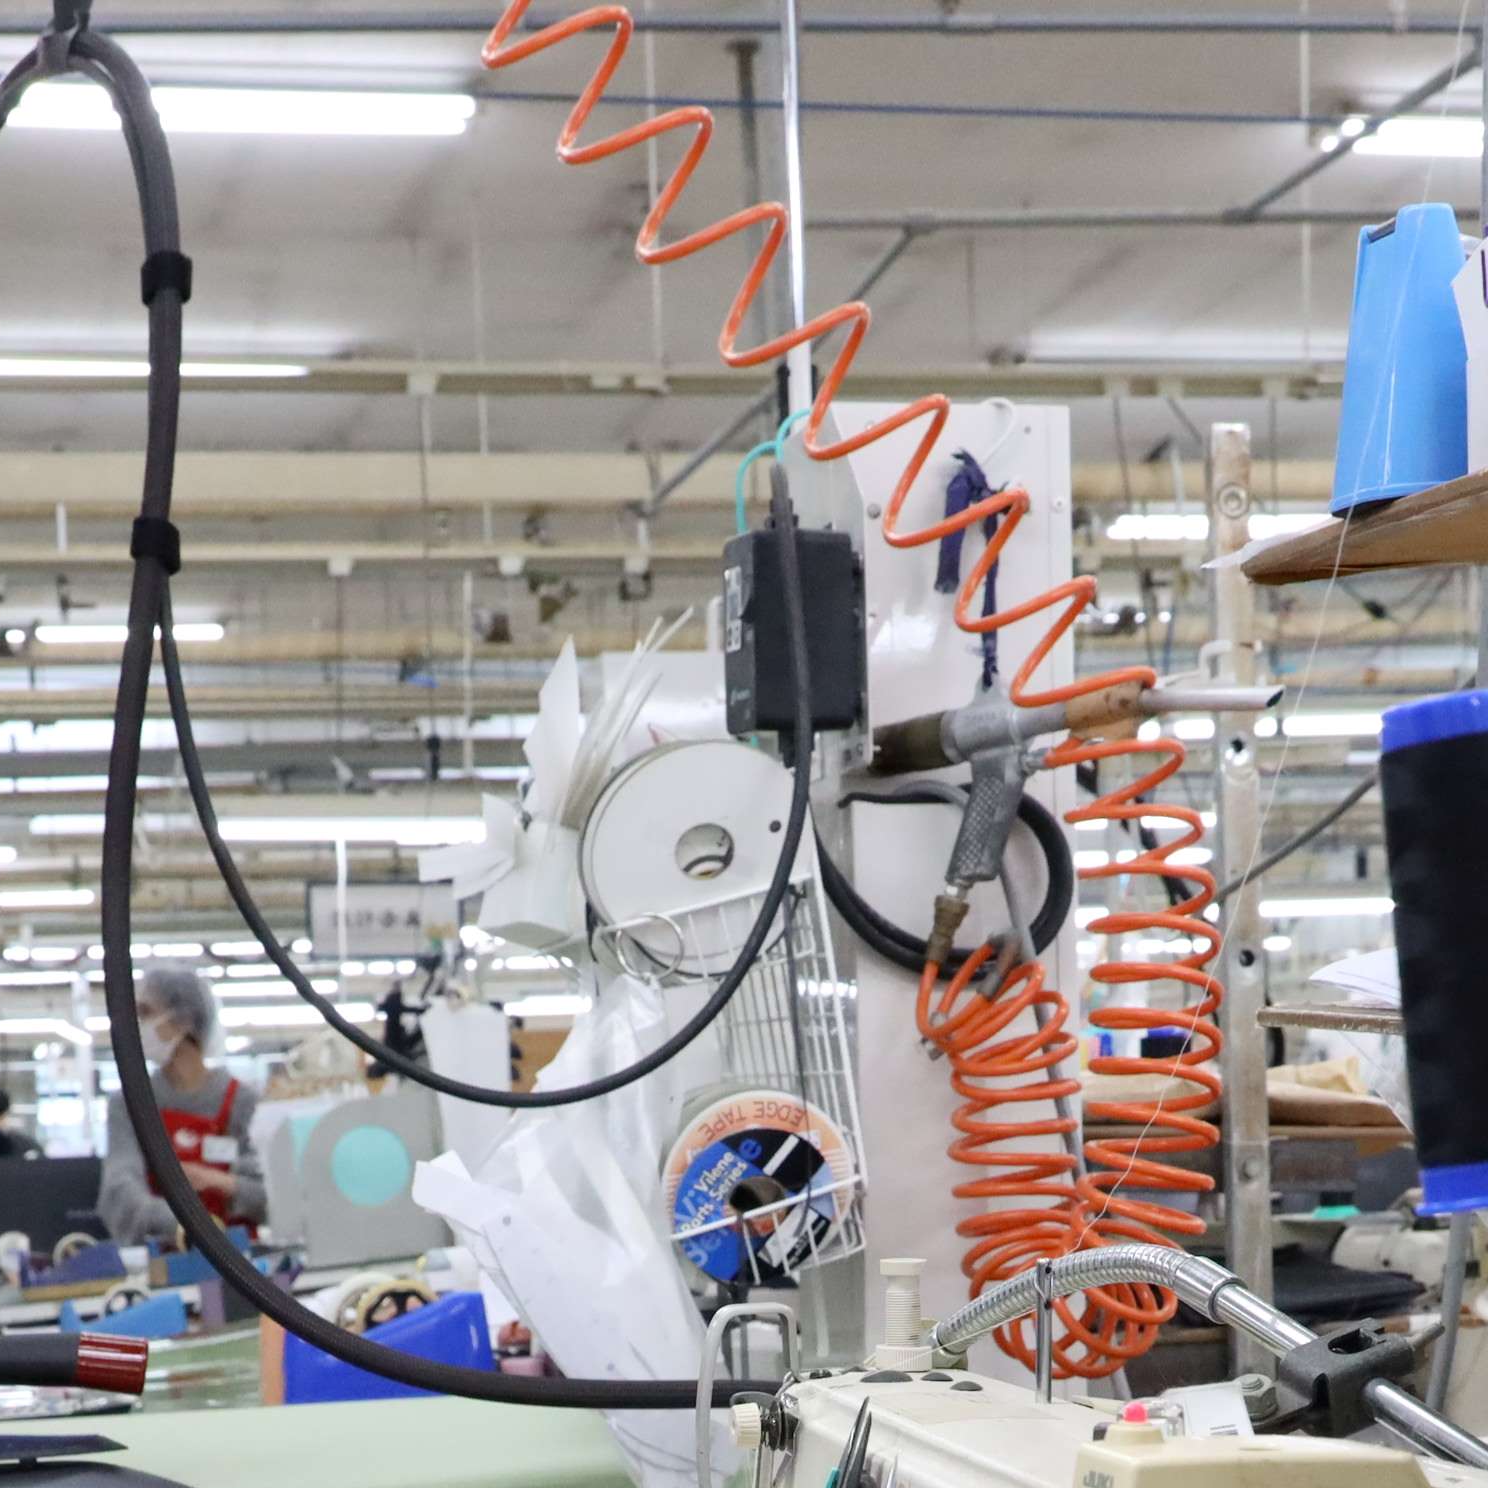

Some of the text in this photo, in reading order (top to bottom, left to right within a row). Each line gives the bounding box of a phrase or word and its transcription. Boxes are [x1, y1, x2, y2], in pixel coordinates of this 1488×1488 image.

[698, 1100, 807, 1141] EDGE TAPE
[693, 1151, 736, 1193] Vilene
[708, 1161, 748, 1201] Series
